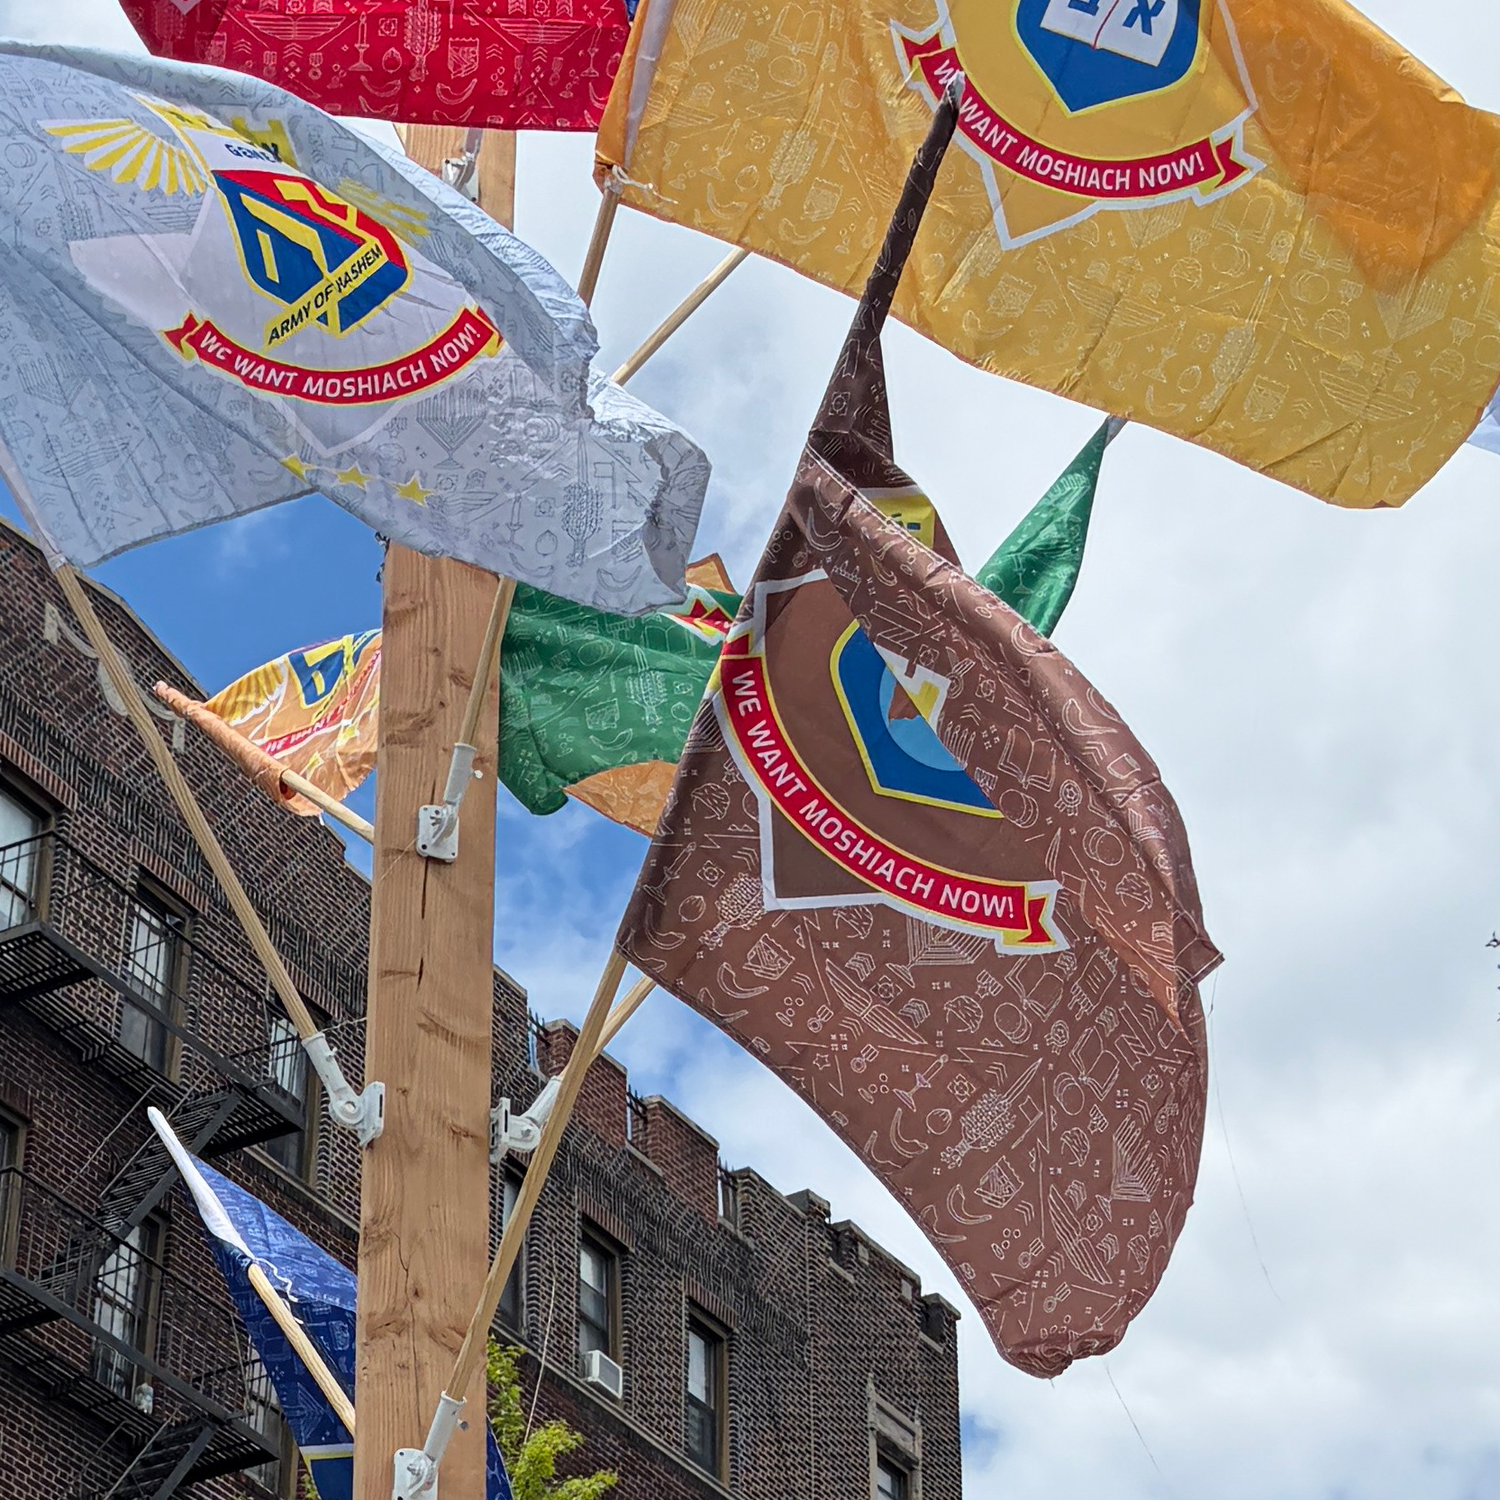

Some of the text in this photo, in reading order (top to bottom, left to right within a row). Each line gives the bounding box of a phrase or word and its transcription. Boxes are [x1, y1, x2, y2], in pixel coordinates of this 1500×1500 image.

[959, 96, 1018, 156] WANT
[1015, 145, 1131, 191] MOSHIACH
[1138, 151, 1206, 189] NOW!
[267, 243, 384, 346] ARMY OF HASHEM
[233, 354, 299, 390] WANT
[301, 359, 428, 398] MOSHIACH
[429, 322, 482, 373] NOW!
[731, 669, 1015, 919] WE WANT MOSHIACH NOW!
